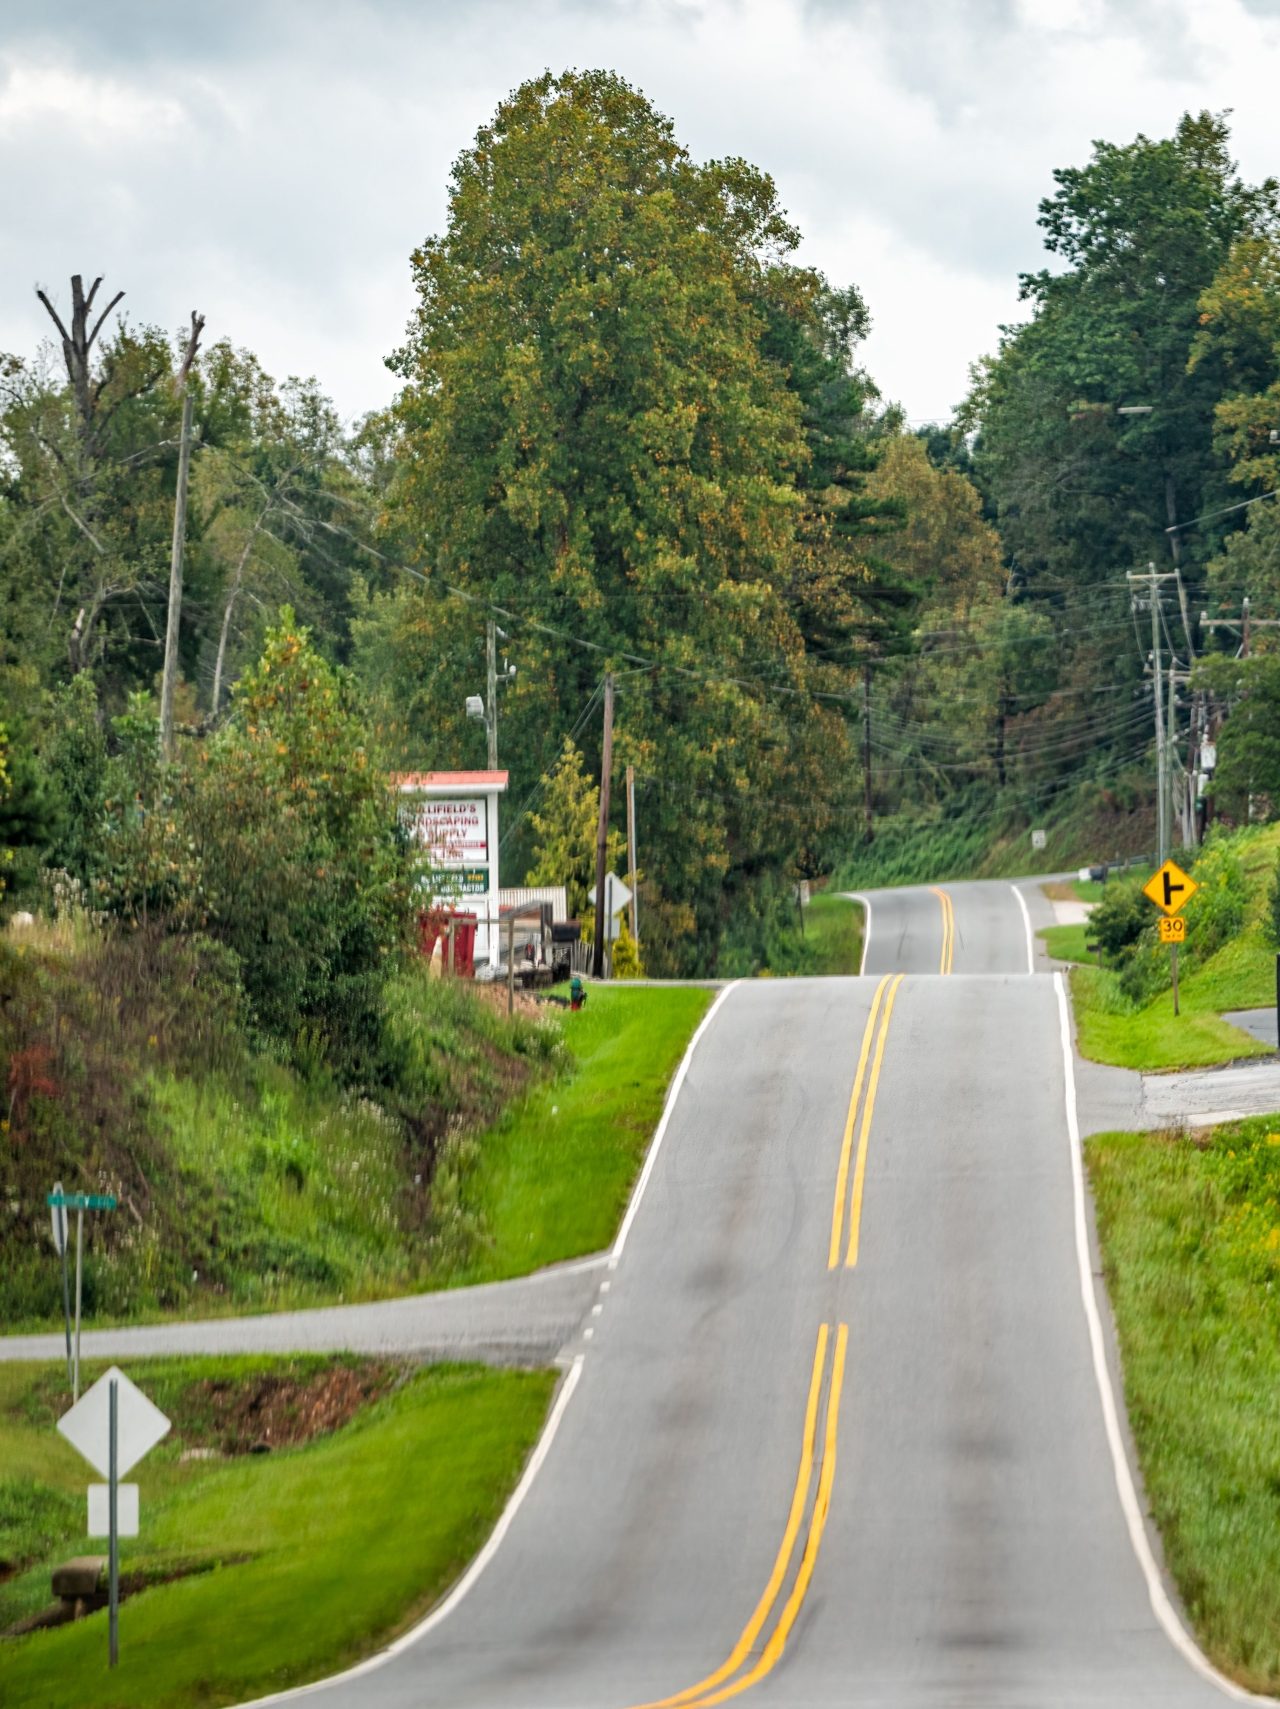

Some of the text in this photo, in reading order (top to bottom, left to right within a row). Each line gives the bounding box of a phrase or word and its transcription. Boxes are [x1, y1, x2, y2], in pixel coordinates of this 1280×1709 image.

[412, 804, 476, 814] LLIFIELD'S
[411, 816, 479, 826] NDSCAPING
[1163, 920, 1183, 932] 30
